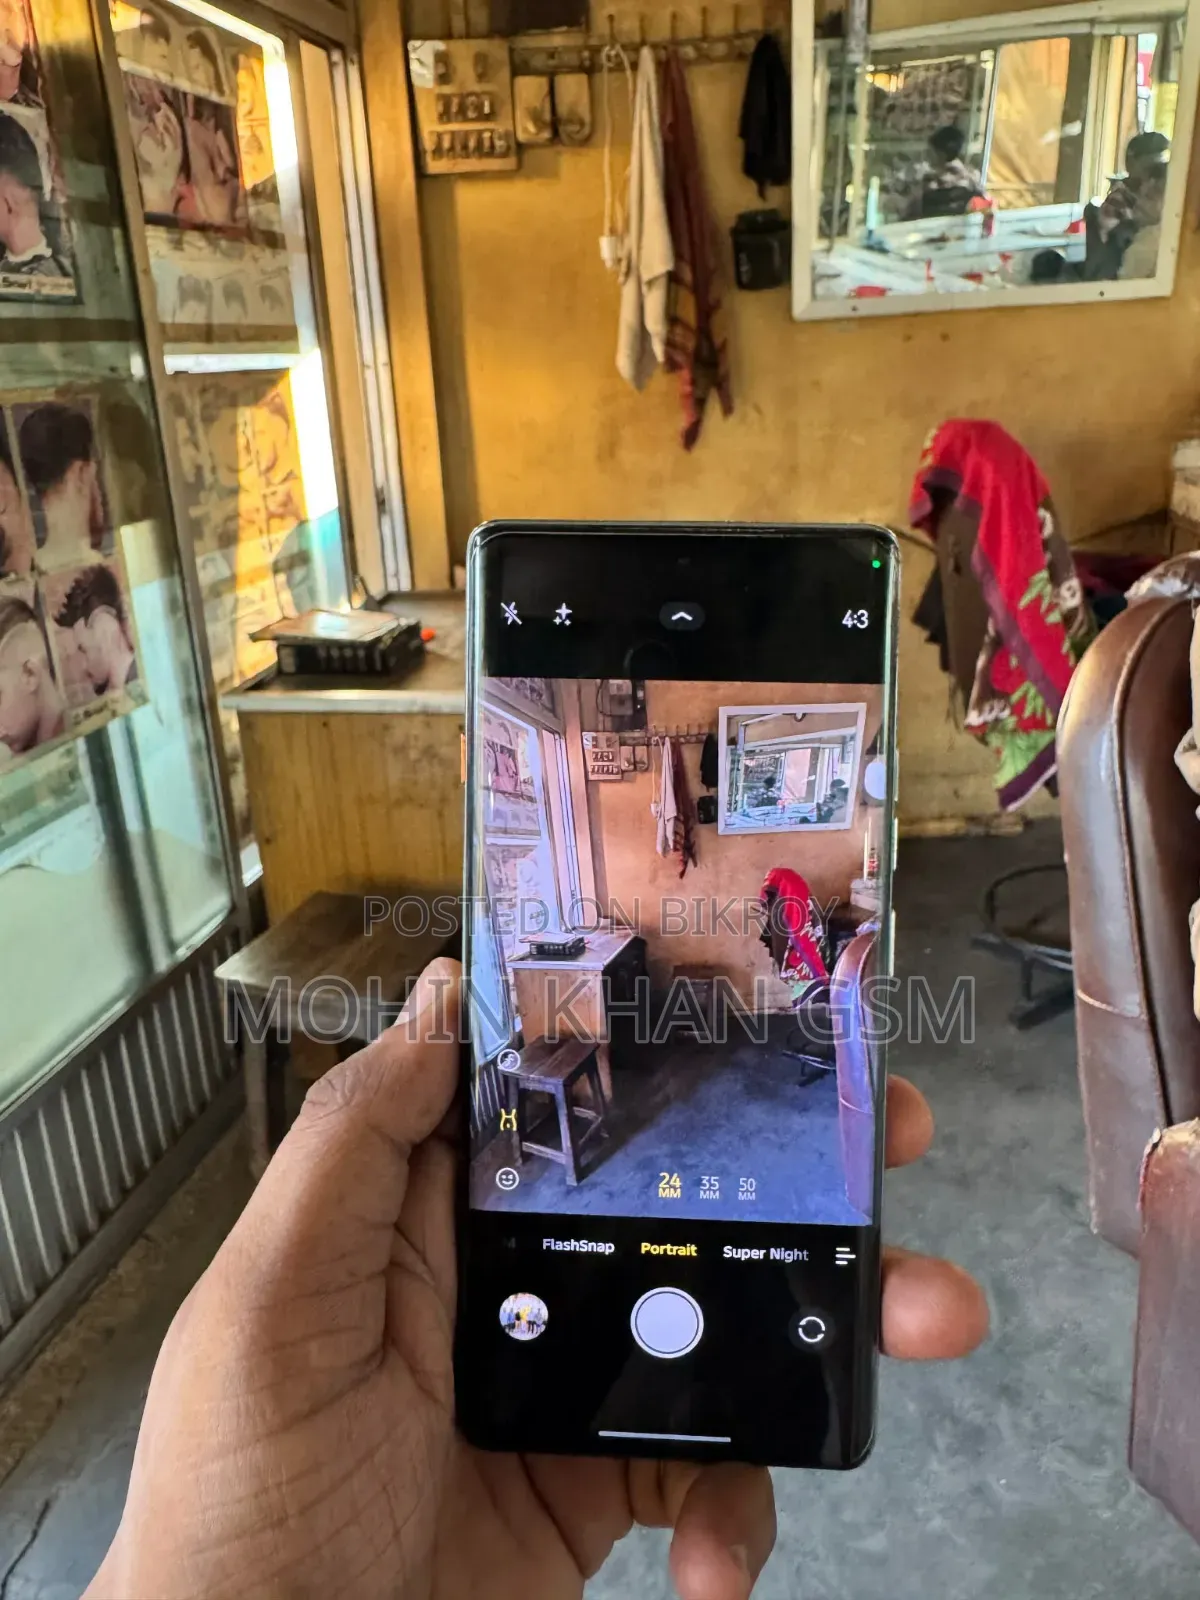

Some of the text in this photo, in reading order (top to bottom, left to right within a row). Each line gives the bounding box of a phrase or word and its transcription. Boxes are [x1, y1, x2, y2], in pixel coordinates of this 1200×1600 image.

[842, 609, 869, 629] 4:3
[658, 1172, 682, 1188] 24
[700, 1175, 720, 1190] 35
[738, 1177, 756, 1191] 50
[658, 1188, 681, 1198] MM
[699, 1190, 720, 1200] MM
[738, 1191, 756, 1201] MM
[542, 1238, 616, 1255] FlashSnap
[640, 1242, 698, 1257] Portrait
[723, 1245, 809, 1263] Super Night
